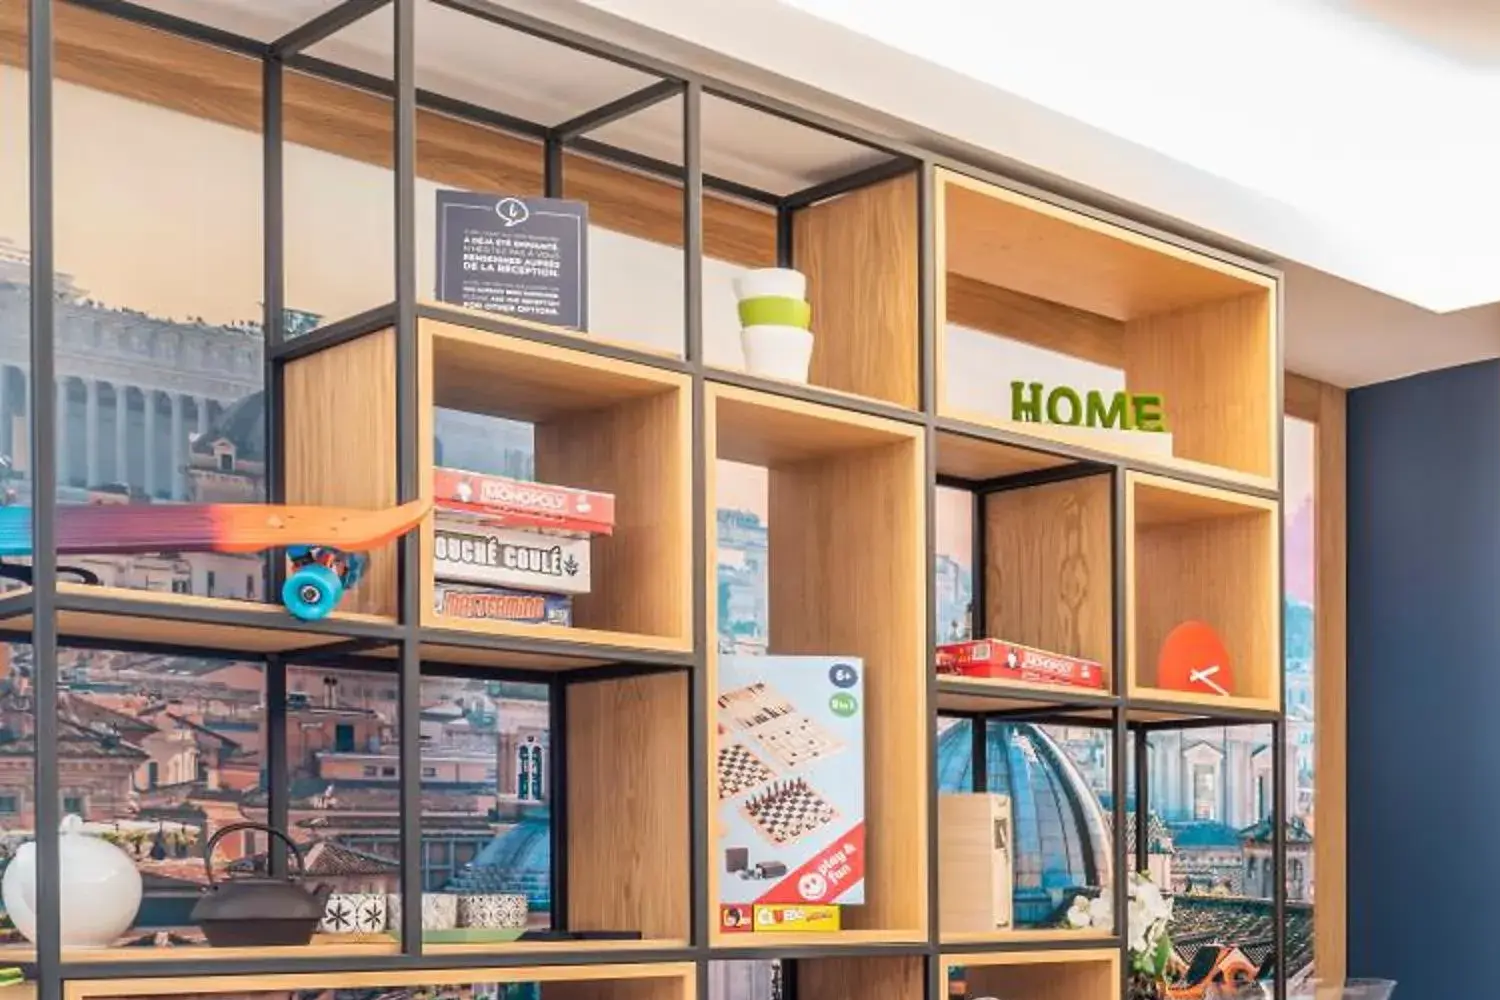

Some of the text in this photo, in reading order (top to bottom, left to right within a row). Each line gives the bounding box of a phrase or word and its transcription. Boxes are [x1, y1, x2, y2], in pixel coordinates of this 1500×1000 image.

[463, 261, 478, 271] DE
[480, 263, 495, 272] LA
[1010, 380, 1166, 433] HOME
[504, 544, 563, 576] COULÉ
